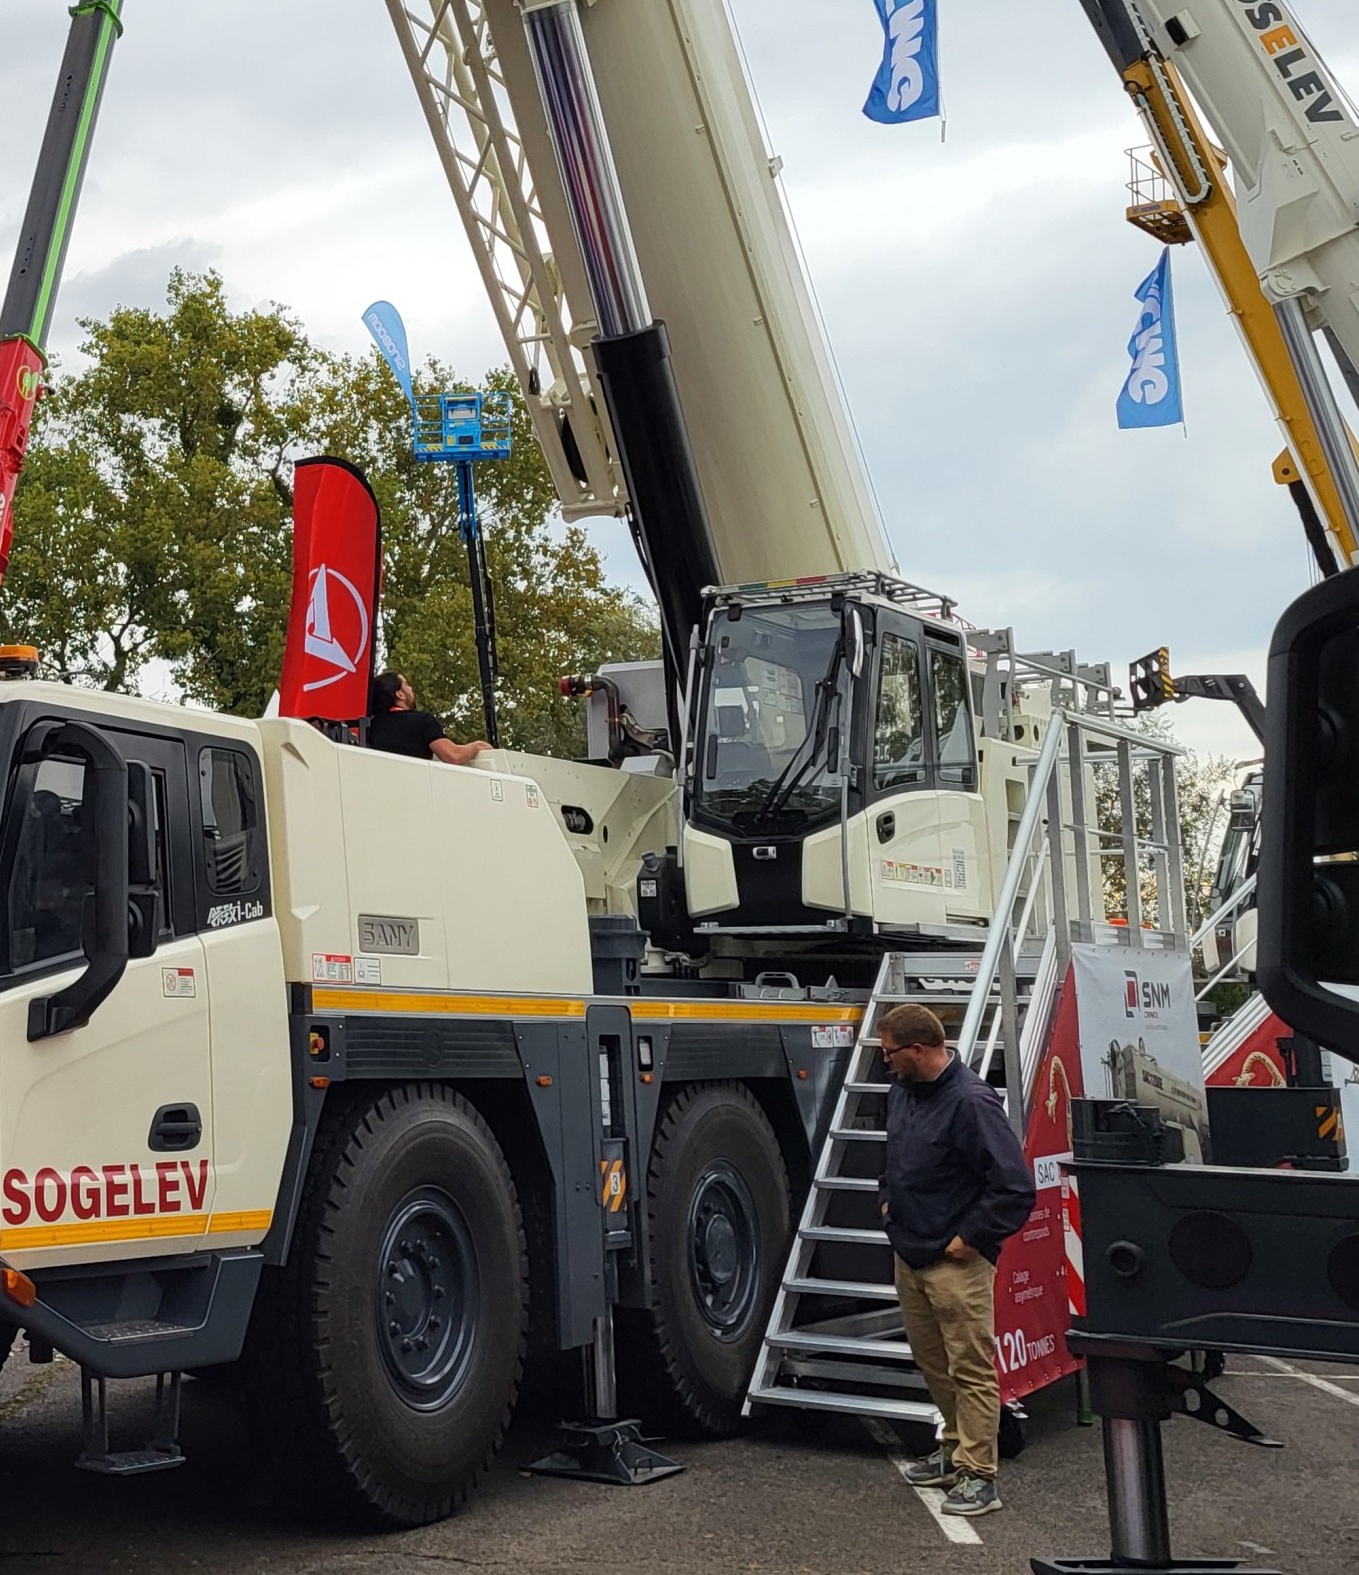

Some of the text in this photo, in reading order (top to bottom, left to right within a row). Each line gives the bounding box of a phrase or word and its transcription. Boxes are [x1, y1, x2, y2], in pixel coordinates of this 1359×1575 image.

[1236, 0, 1345, 123] SELEV
[363, 922, 414, 948] SANY
[1142, 981, 1172, 1009] SNM
[612, 1174, 619, 1193] 3
[1037, 1161, 1055, 1184] SAC
[1, 1159, 209, 1226] SOGELEV
[995, 1328, 1055, 1374] 120 TONNES
